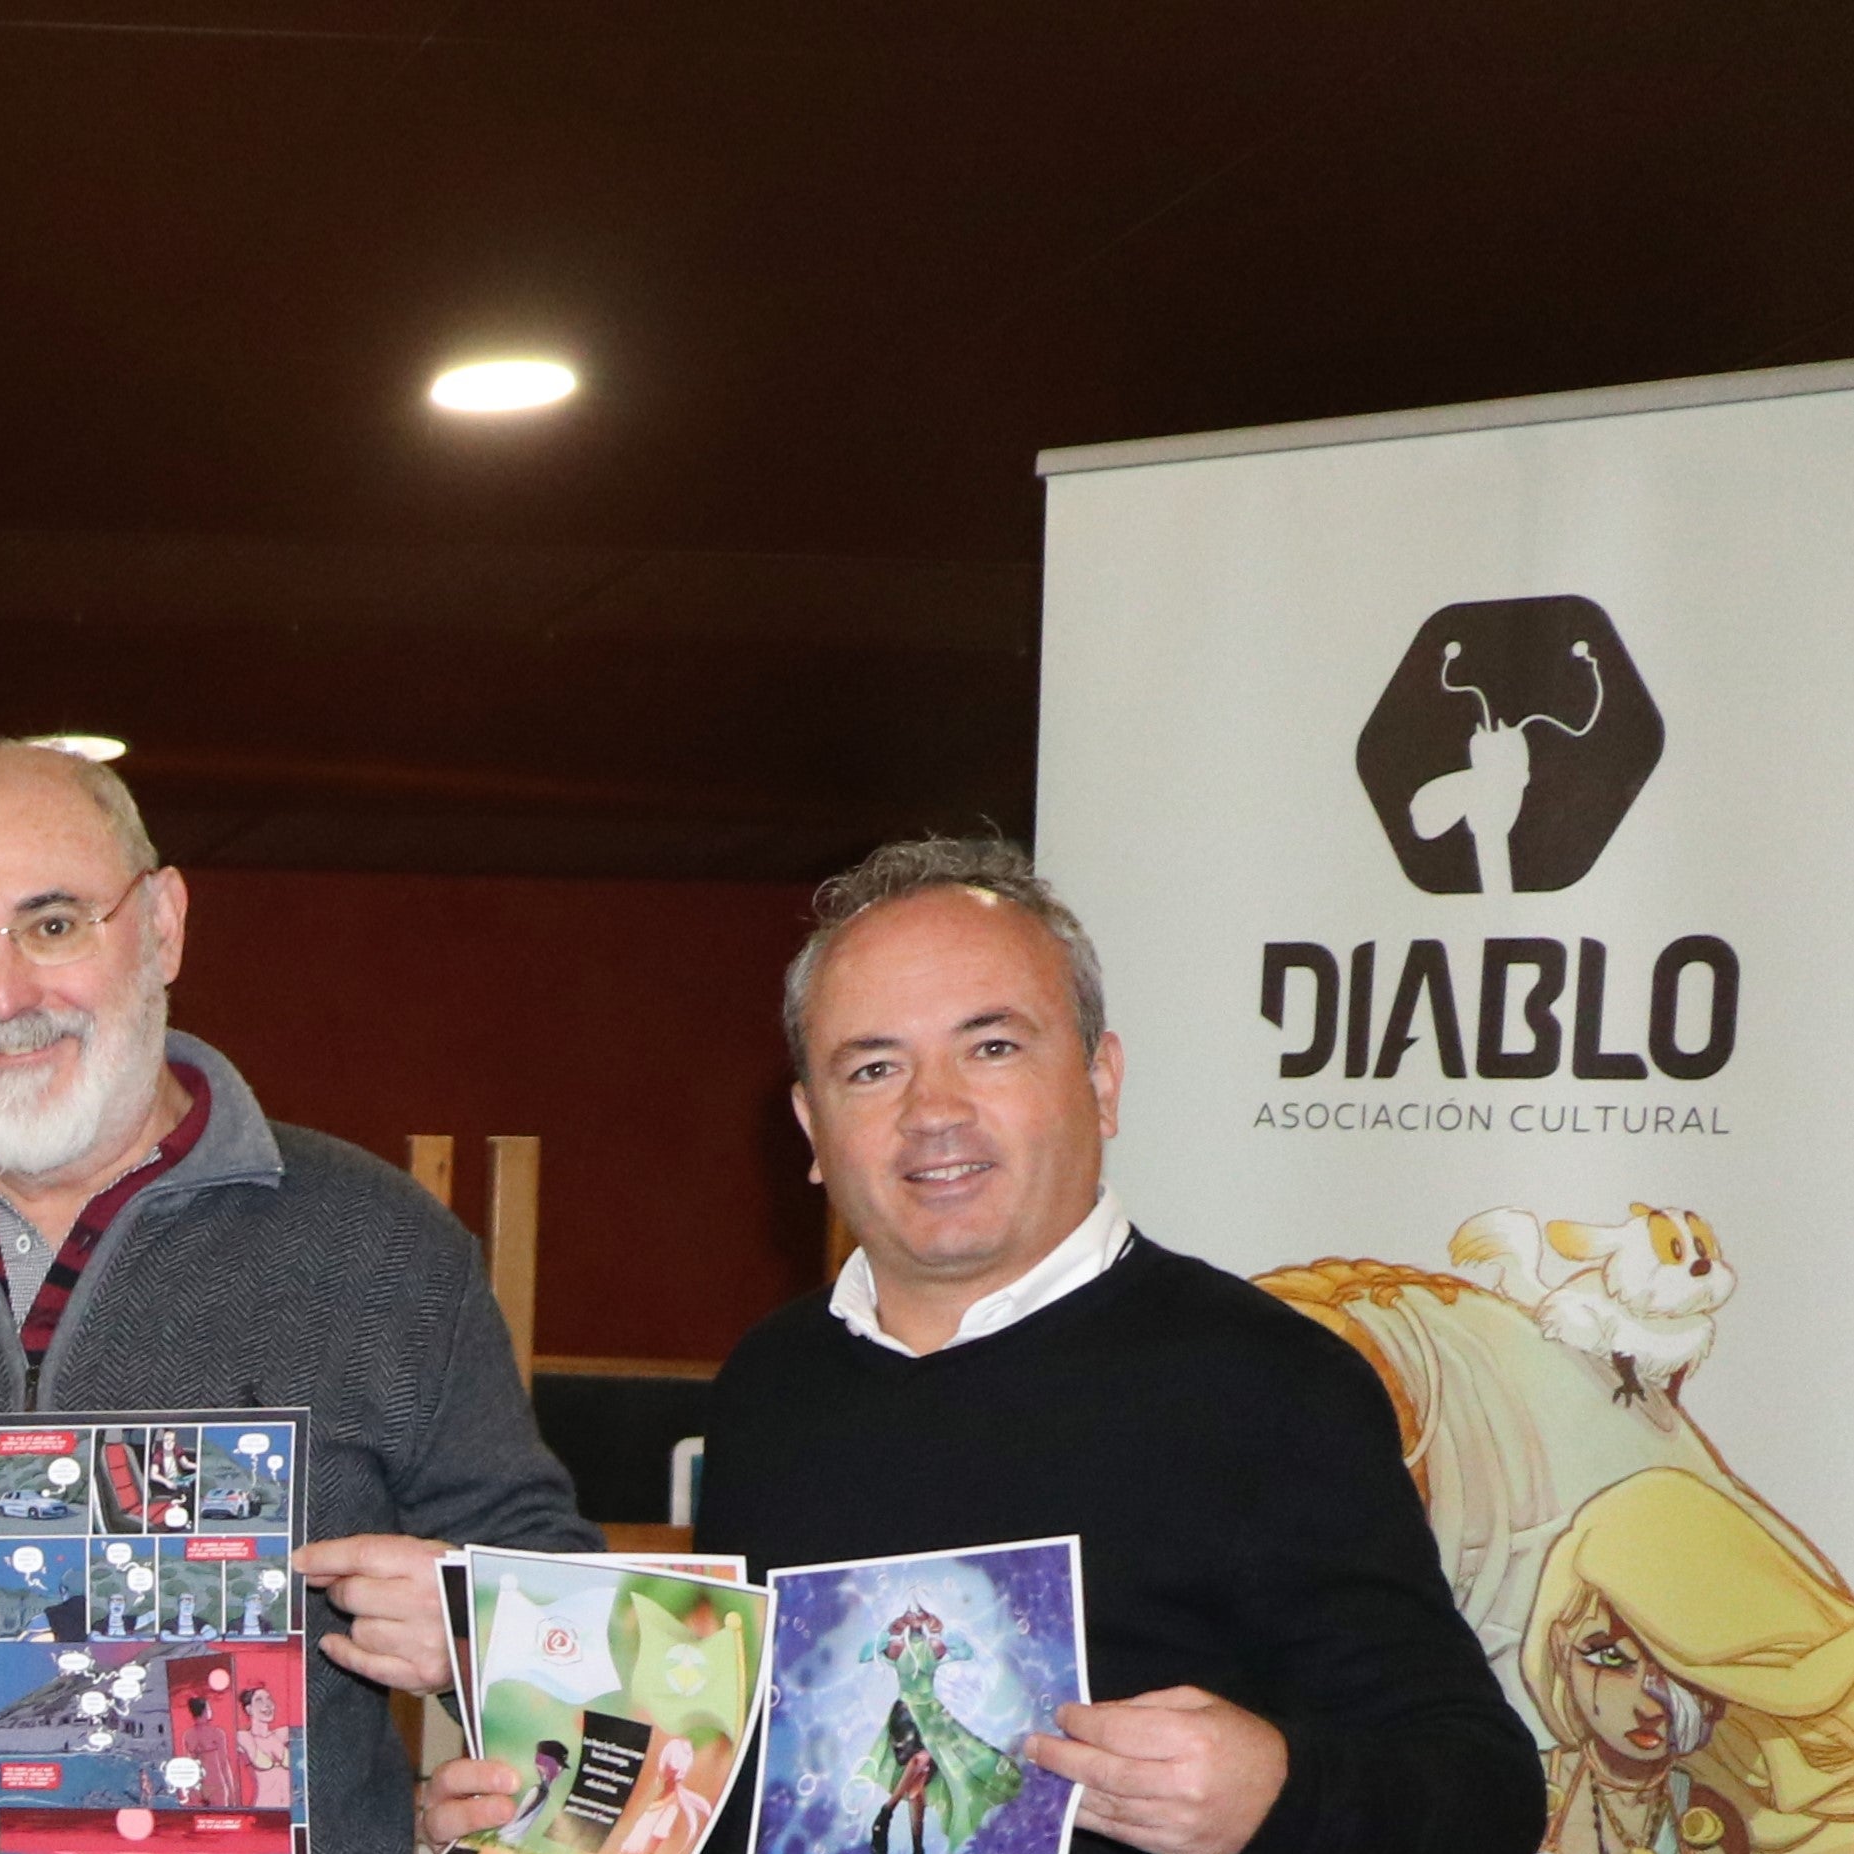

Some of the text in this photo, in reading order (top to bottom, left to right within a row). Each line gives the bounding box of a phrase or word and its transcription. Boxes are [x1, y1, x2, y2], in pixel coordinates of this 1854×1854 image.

[1259, 934, 1741, 1080] DIABLO
[1253, 1096, 1731, 1136] ASOCIACIÓN CULTURAL
